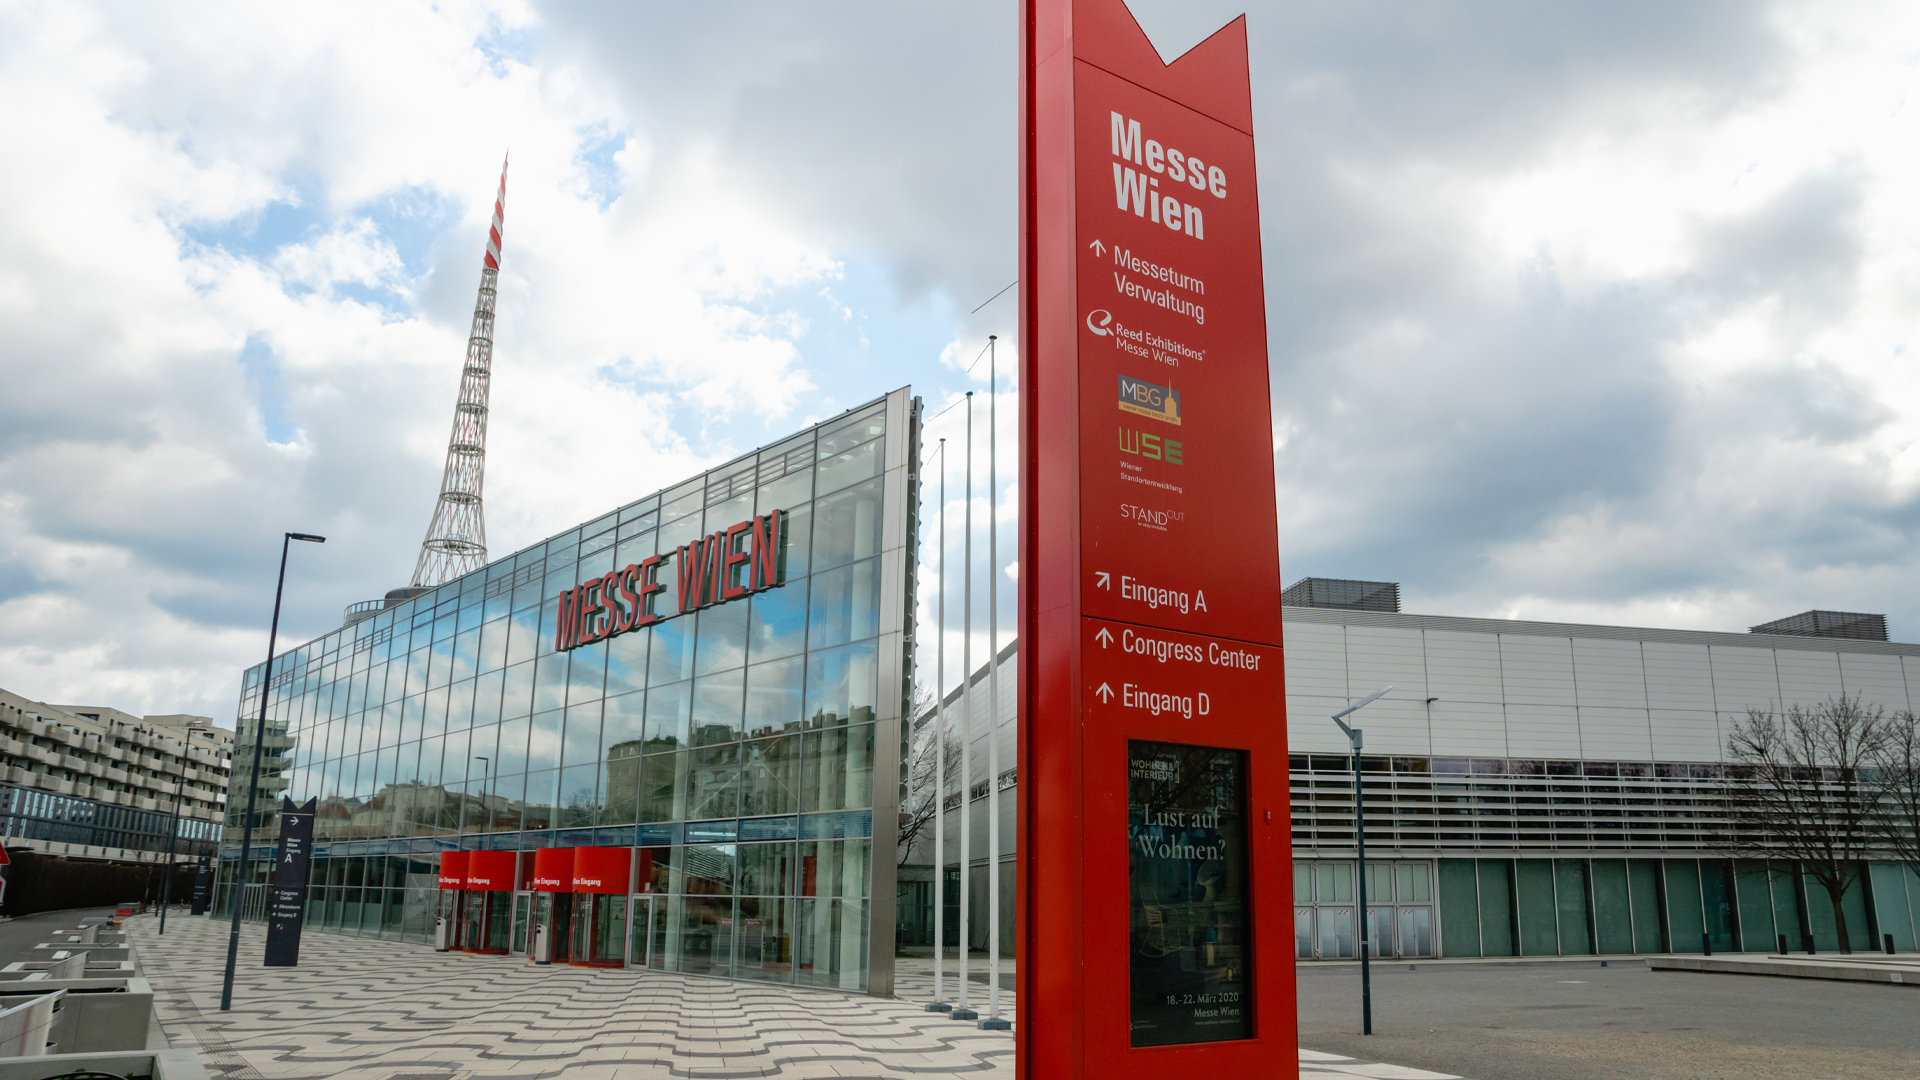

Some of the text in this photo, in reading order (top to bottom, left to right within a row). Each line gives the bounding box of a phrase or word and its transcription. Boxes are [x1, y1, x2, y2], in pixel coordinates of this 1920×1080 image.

[1110, 110, 1227, 199] Messe
[1112, 161, 1204, 241] Wien
[1114, 245, 1205, 295] Messeturm
[1113, 271, 1205, 325] Verwaltung
[1116, 322, 1143, 342] Reed
[1116, 337, 1179, 367] Messe Wien
[1122, 379, 1161, 407] MBG
[1119, 426, 1183, 466] WSE
[1120, 460, 1142, 472] Wiener
[1120, 472, 1183, 494] Standortentwicklung
[555, 508, 783, 652] MESSE WIEN
[1121, 575, 1207, 615] Eingang A
[1122, 629, 1261, 671] Congress Center
[1123, 682, 1210, 720] Eingang D
[1130, 759, 1174, 772] WOHNEN &
[1130, 769, 1174, 781] INTERIEUR
[1144, 803, 1227, 829] Lust auf
[284, 853, 292, 863] A
[1138, 833, 1226, 861] Wohnen?
[444, 877, 460, 885] Eingang
[473, 877, 490, 885] Eingang
[541, 877, 560, 886] Eingang
[581, 877, 601, 887] Eingang
[1197, 993, 1217, 1003] März
[1218, 992, 1239, 1003] 2020
[1194, 1006, 1240, 1018] Messe Wien
